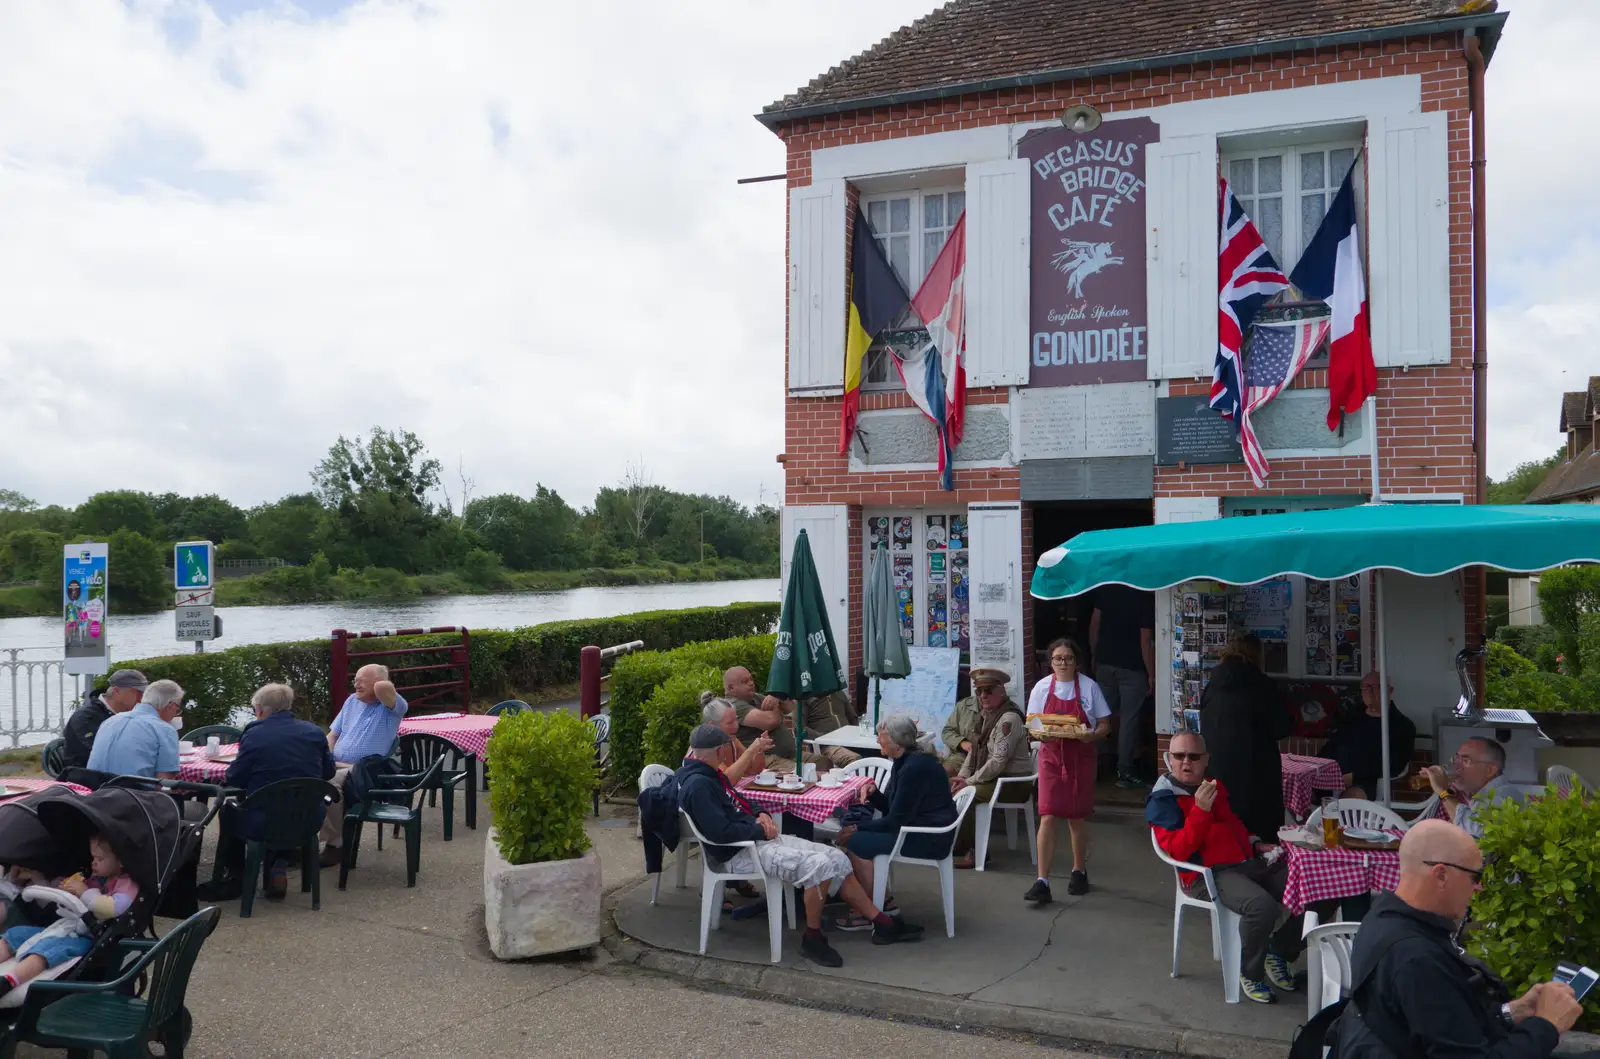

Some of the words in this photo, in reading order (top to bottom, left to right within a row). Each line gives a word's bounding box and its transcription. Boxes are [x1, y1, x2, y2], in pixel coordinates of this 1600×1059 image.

[1033, 138, 1138, 180] PEGASUS
[1060, 166, 1146, 203] BRIDGE
[1048, 194, 1121, 231] CAFÉ
[1047, 308, 1086, 326] English
[1091, 305, 1130, 322] Spoken
[1033, 322, 1147, 367] GONDRÉE
[187, 629, 211, 637] SERVICE
